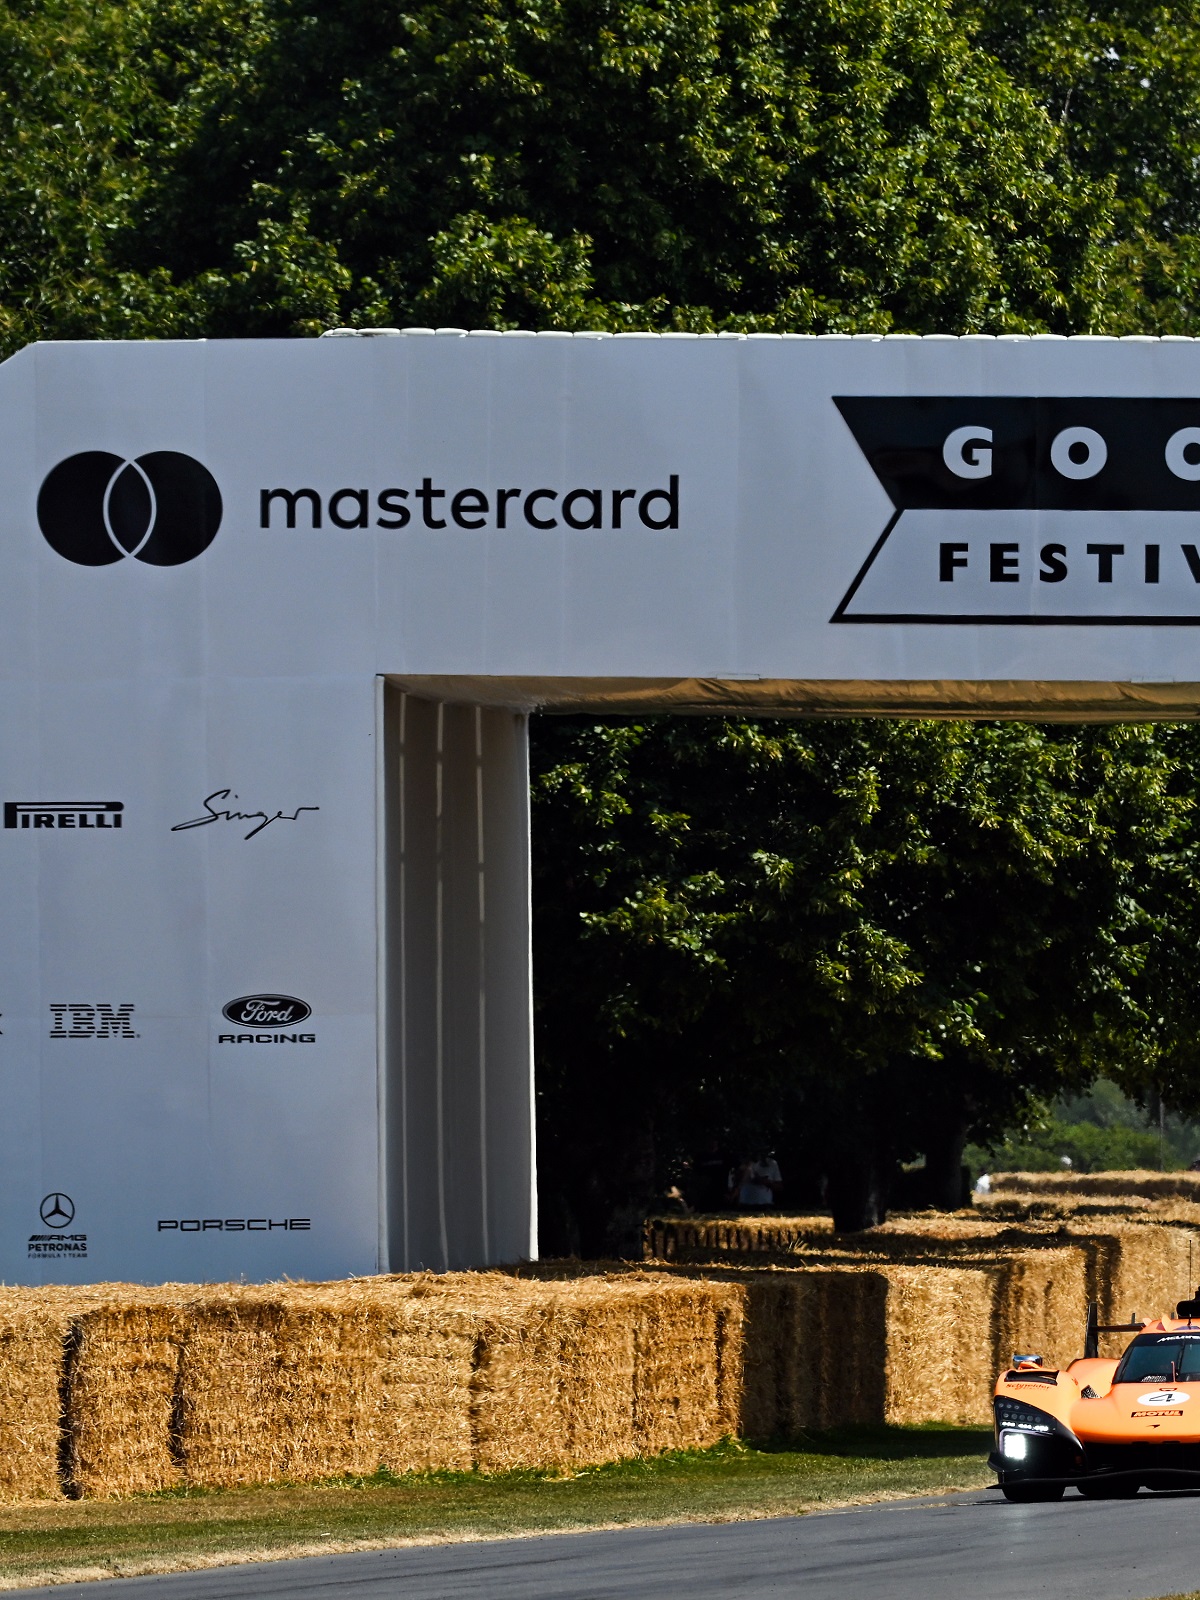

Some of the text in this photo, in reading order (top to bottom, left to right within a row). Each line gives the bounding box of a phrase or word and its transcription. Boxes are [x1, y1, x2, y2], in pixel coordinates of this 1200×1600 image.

[259, 474, 680, 531] mastercard
[3, 801, 125, 829] PIRELLI
[171, 788, 320, 841] Singer
[49, 1003, 136, 1039] IBM
[239, 998, 297, 1026] Ford
[217, 1033, 316, 1044] RACING
[157, 1218, 311, 1232] PORSCHE
[28, 1243, 87, 1251] PETRONAS
[1148, 1392, 1176, 1402] 4
[1132, 1410, 1183, 1418] MOTUL
